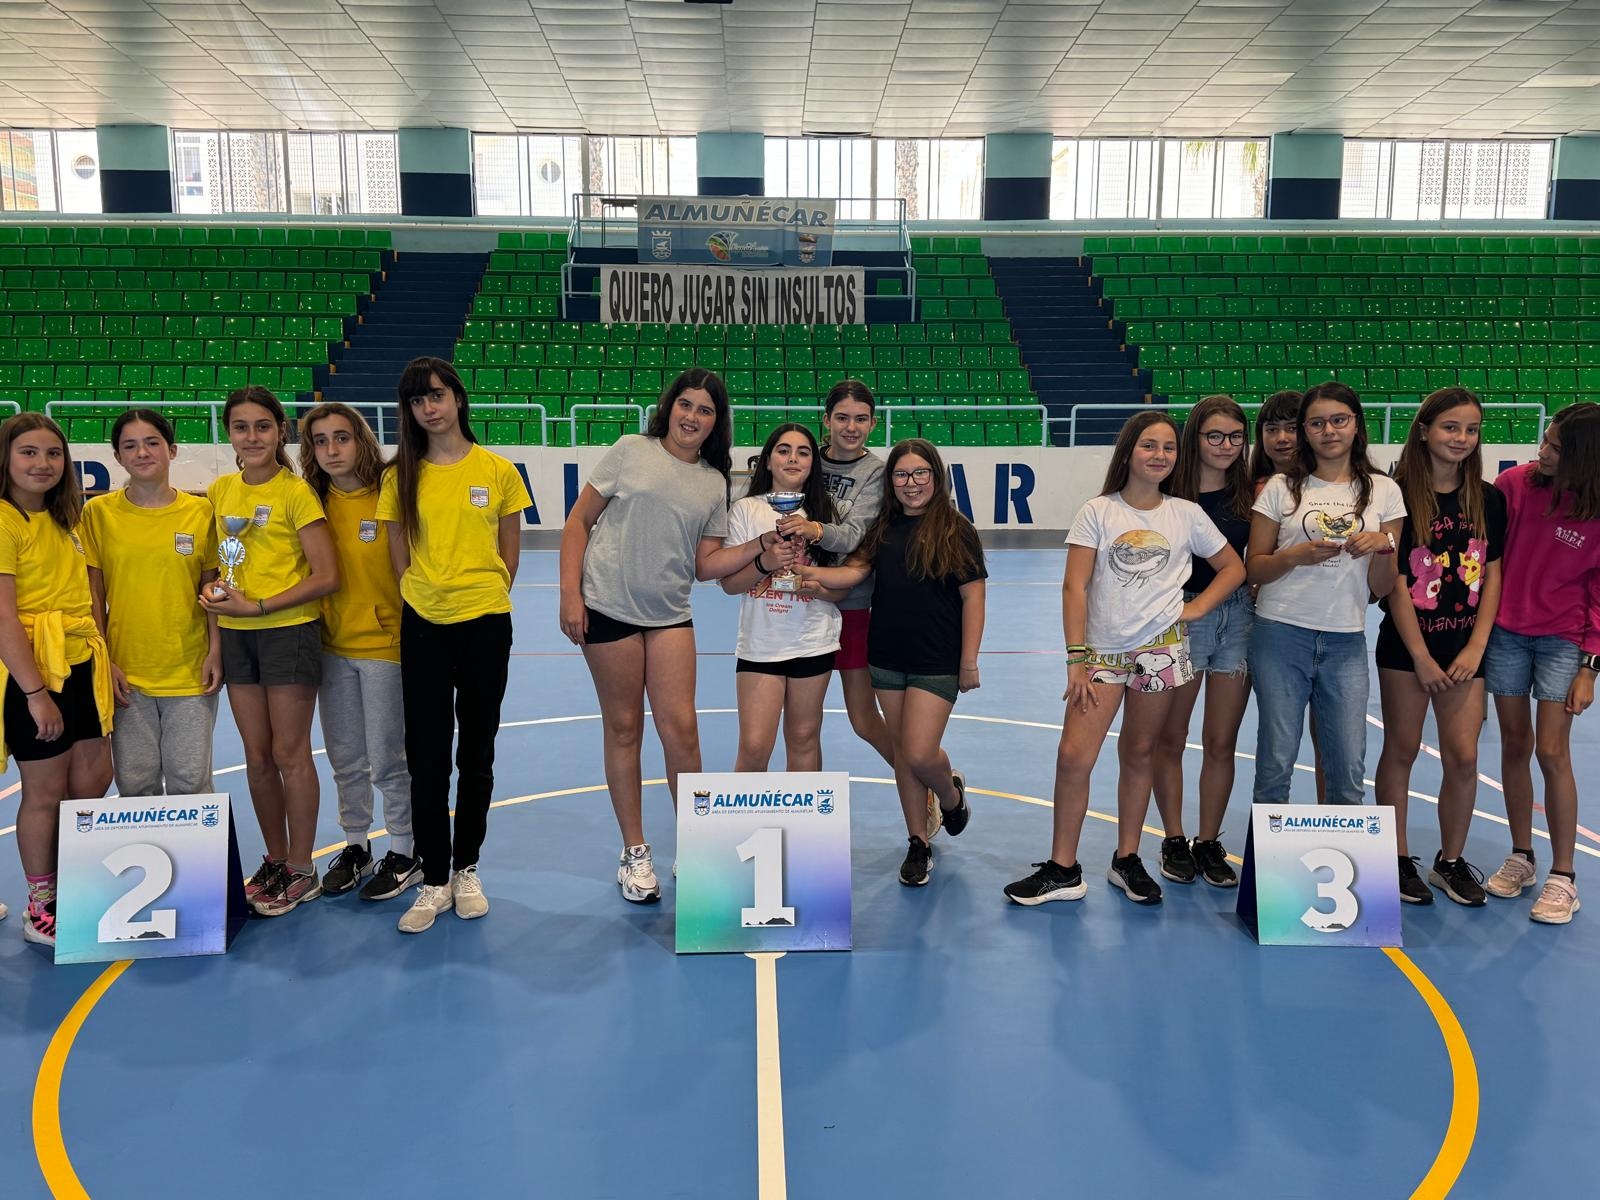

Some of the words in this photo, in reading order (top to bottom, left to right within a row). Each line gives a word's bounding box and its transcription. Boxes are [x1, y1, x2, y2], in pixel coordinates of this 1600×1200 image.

[645, 200, 828, 227] ALMUÑÉCAR
[609, 269, 673, 323] QUIERO
[679, 274, 735, 324] JUGAR
[741, 276, 769, 324] SIN
[776, 274, 856, 325] INSULTOS
[96, 806, 199, 825] ALMUÑÉCAR
[713, 789, 815, 807] ALMUÑÉCAR
[1285, 815, 1364, 828] ALMUÑÉCAR
[98, 843, 177, 943] 2
[735, 827, 795, 928] 1
[1300, 848, 1359, 933] 3
